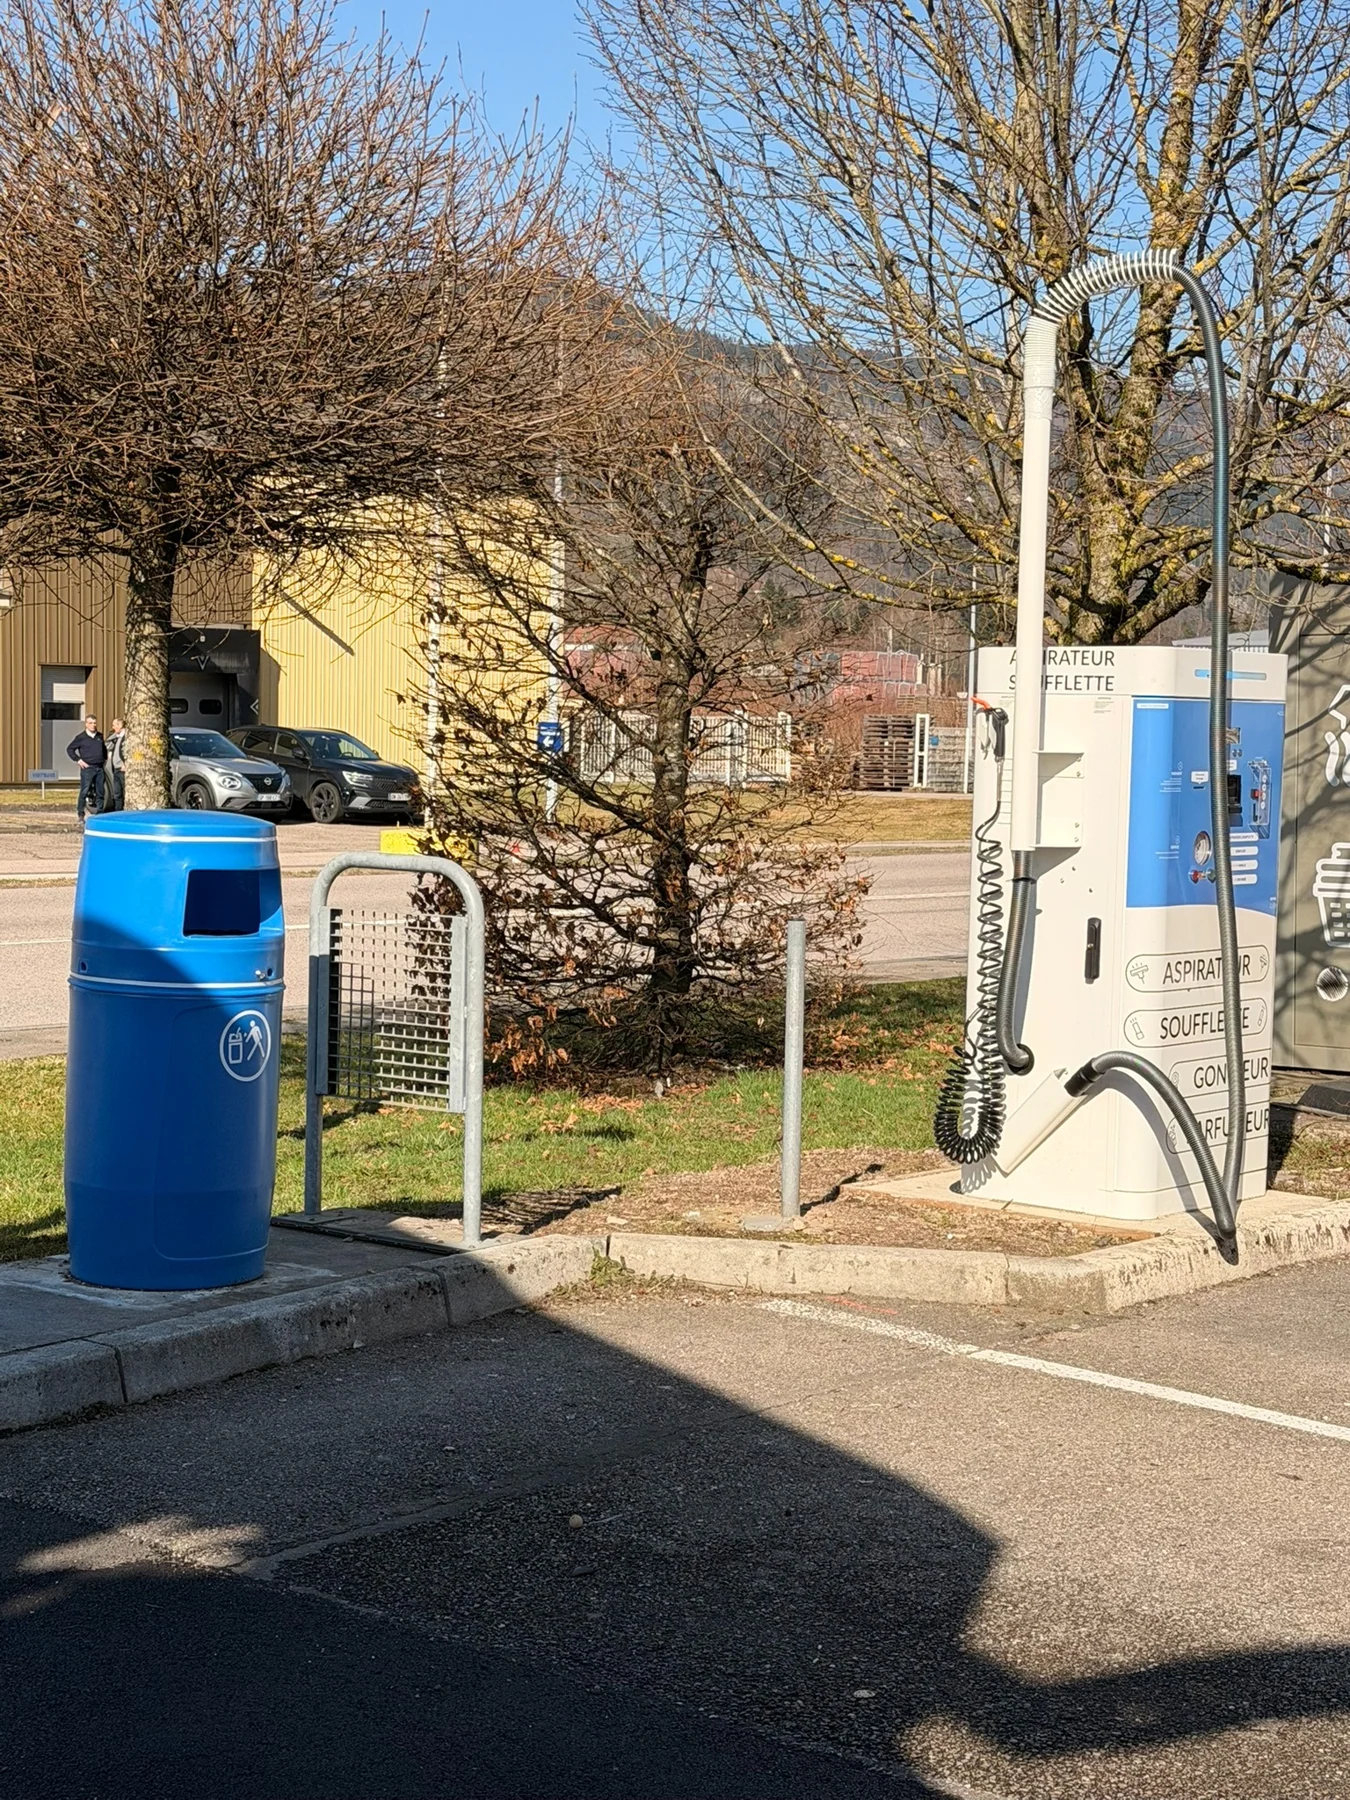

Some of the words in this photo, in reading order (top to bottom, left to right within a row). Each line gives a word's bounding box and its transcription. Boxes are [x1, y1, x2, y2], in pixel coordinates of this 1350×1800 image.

[1009, 650, 1115, 666] AIRATEUR
[1009, 674, 1115, 691] SFFLETTE
[1162, 954, 1251, 985] ASPIRATR
[1160, 1007, 1250, 1040] SOUFFLEE
[1193, 1057, 1269, 1089] GONEUR
